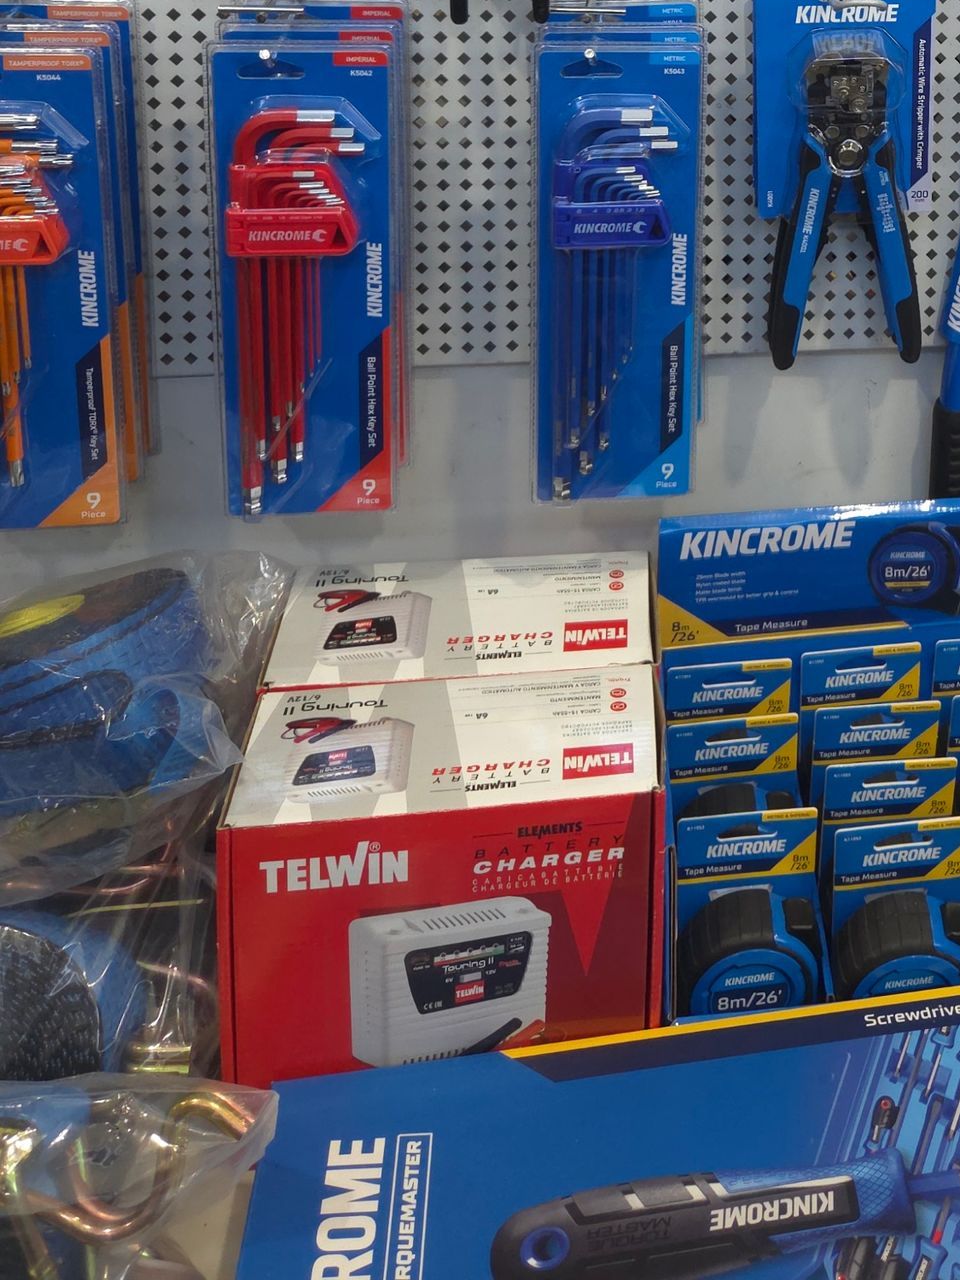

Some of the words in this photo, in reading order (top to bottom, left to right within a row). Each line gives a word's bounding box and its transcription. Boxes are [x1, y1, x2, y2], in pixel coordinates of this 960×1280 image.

[795, 4, 899, 24] KINCROME
[345, 55, 377, 64] IMPERIAL
[663, 55, 686, 63] METRIC
[917, 38, 927, 76] Automatic
[917, 76, 927, 94] Wire
[915, 94, 927, 125] Stripper
[916, 124, 926, 140] with
[914, 141, 925, 170] Crimper
[911, 190, 928, 199] 200
[248, 228, 317, 242] KINCROME
[573, 221, 633, 234] KINCROME
[671, 233, 687, 307] KINCROME
[82, 249, 96, 327] KINCROME
[366, 242, 382, 317] KINCROME
[668, 345, 678, 361] Ball
[367, 356, 377, 373] Ball
[667, 362, 678, 384] Point
[366, 374, 377, 397] Point
[667, 385, 678, 401] Hex
[367, 398, 377, 415] Hex
[665, 402, 677, 417] Key
[365, 416, 377, 432] Key
[667, 417, 677, 433] Set
[366, 432, 377, 448] Set
[660, 462, 675, 478] 9
[362, 478, 377, 496] 9
[86, 491, 101, 509] 9
[680, 520, 856, 560] KINCROME
[884, 564, 931, 579] 8m/26'
[671, 621, 690, 632] 8m
[735, 623, 761, 633] Tape
[763, 618, 808, 631] Measure
[445, 631, 554, 646] CHARGER
[564, 622, 628, 649] TELWIN
[825, 670, 895, 688] KINCROME
[692, 686, 764, 703] KINCROME
[839, 727, 912, 744] KINCROME
[563, 749, 633, 772] TELWIN
[694, 743, 769, 761] KINCROME
[432, 757, 551, 776] CHARGER
[850, 786, 927, 803] KINCROME
[517, 821, 583, 840] ELEMENTS
[474, 834, 623, 860] BATTERY
[706, 839, 787, 858] KINCROME
[473, 847, 625, 875] CHARGER
[862, 847, 942, 867] KINCROME
[259, 840, 409, 894] TELWIN
[684, 866, 704, 876] Tape
[706, 863, 742, 874] Measure
[472, 880, 536, 892] CHARGEUR
[565, 871, 623, 883] BATTERIE
[840, 875, 860, 884] Tape
[862, 871, 898, 882] Measure
[724, 972, 775, 987] KINCROME
[885, 976, 934, 990] KINCROME
[455, 984, 484, 999] TELWIN
[717, 990, 782, 1009] 8m/26'
[709, 1189, 836, 1232] KINCROME
